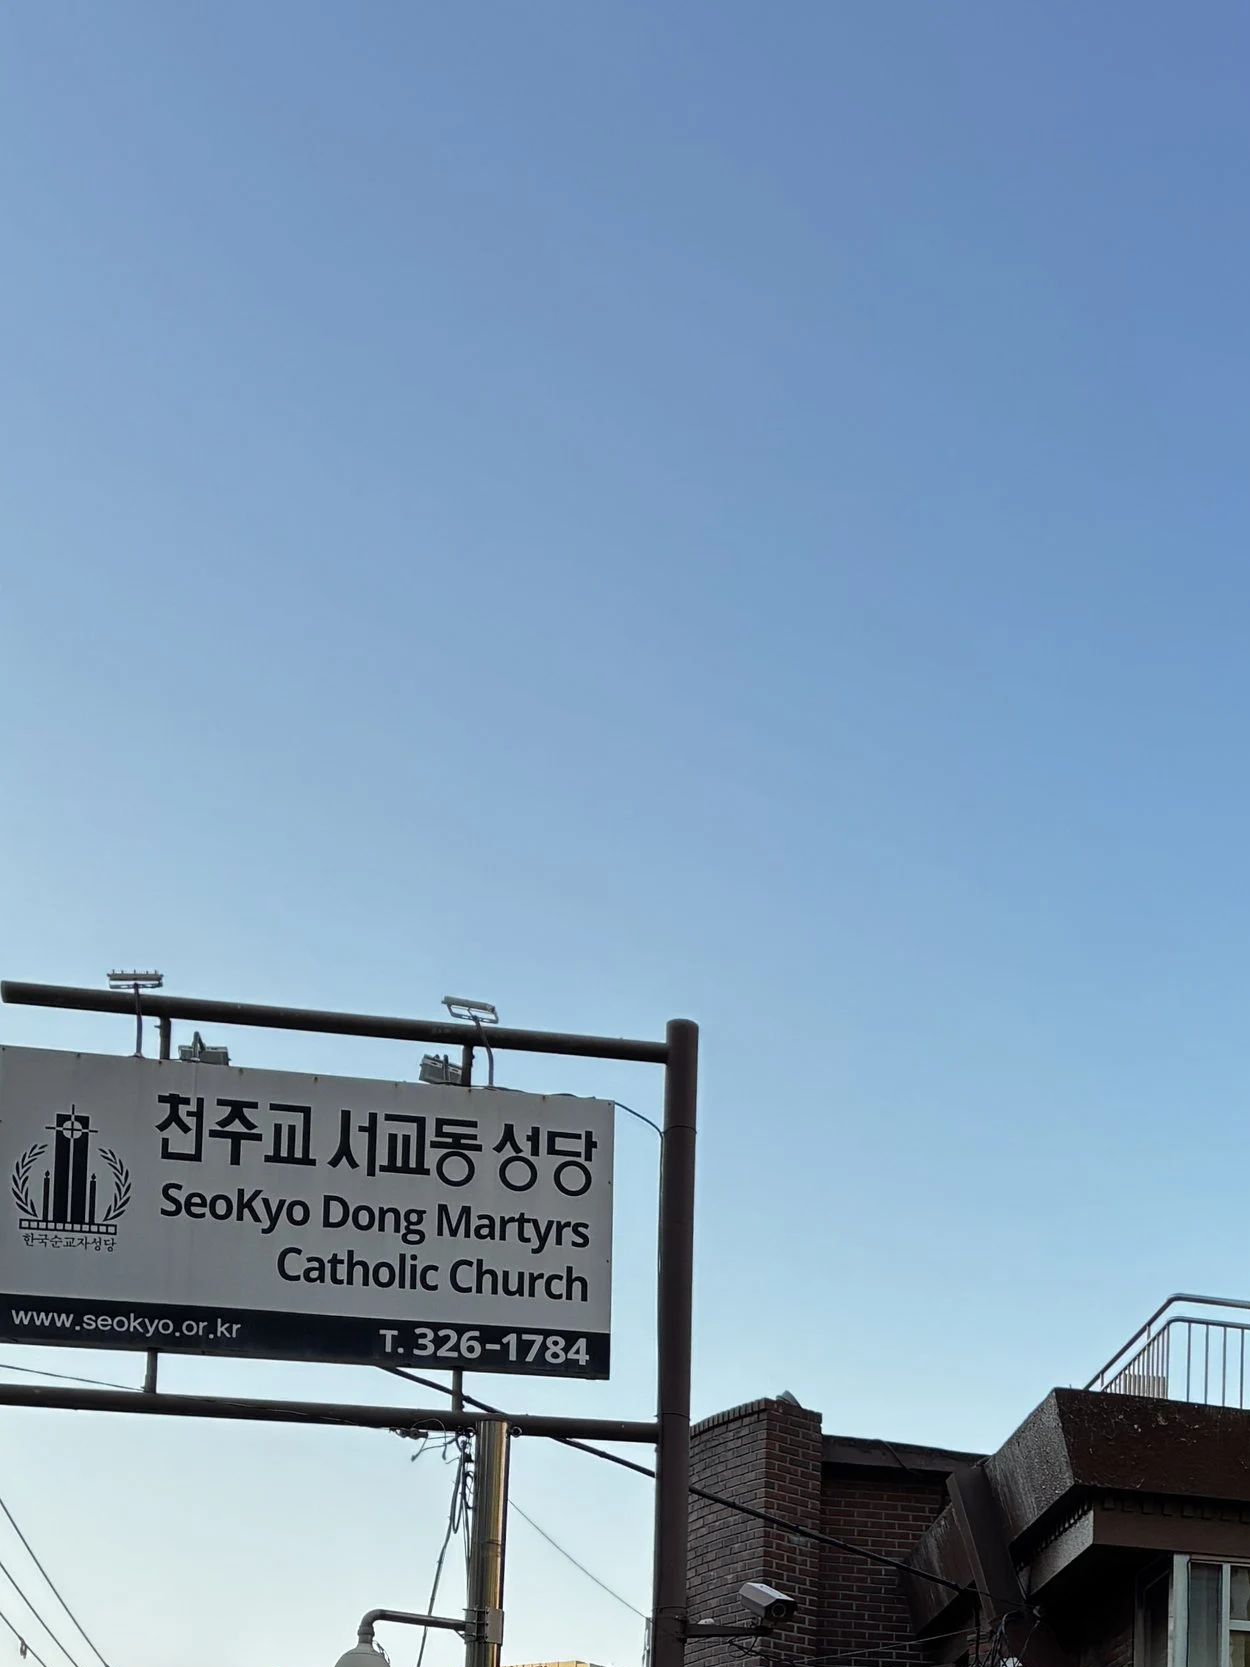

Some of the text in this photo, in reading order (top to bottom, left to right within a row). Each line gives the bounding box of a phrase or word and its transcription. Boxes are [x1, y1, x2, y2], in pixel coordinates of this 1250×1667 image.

[155, 1092, 598, 1198] 천주교 서교동 성당
[22, 1232, 117, 1253] 한국순교자성당
[159, 1183, 590, 1255] SeoKyo Dong Martyrs
[276, 1246, 589, 1302] Catholic Church
[11, 1307, 241, 1341] www.seokyo.or.kr
[379, 1326, 590, 1367] T. 326-1784
